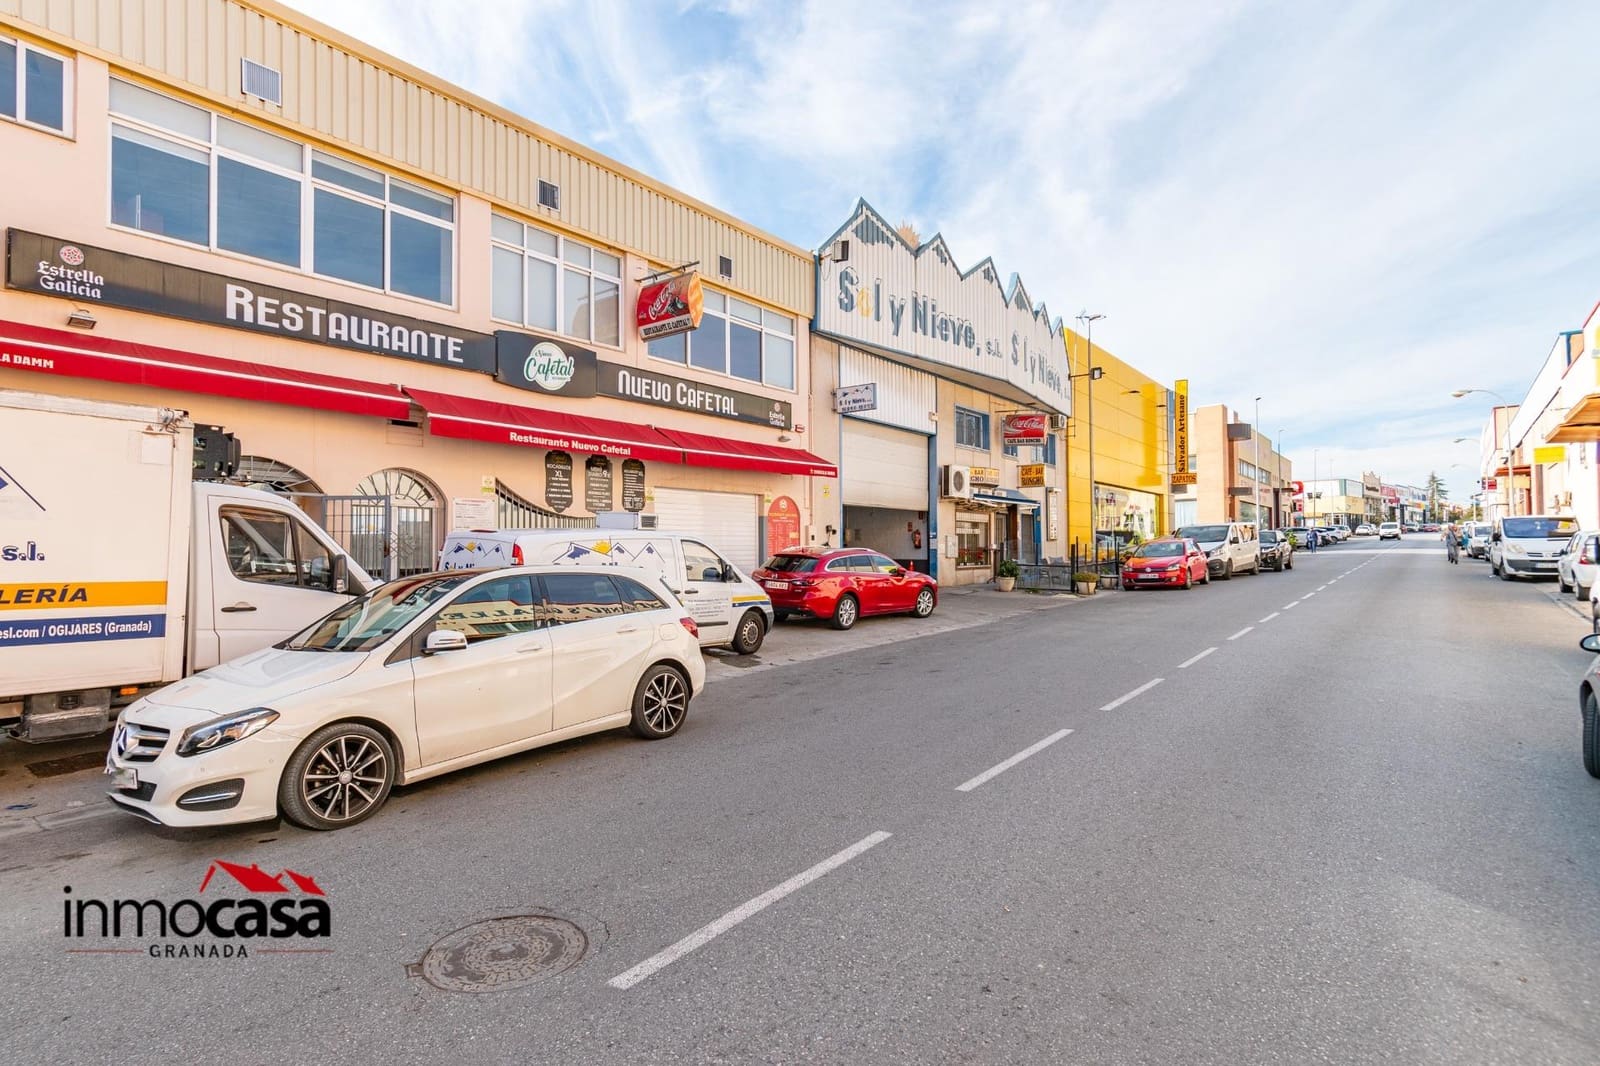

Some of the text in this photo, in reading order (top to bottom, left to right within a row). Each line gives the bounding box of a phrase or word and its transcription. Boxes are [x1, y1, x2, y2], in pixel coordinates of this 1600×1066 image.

[37, 261, 104, 286] Estrella
[40, 275, 102, 299] Galicia
[226, 283, 464, 363] RESTAURANTE
[13, 354, 54, 369] DAMM
[526, 356, 574, 381] Cafetal
[618, 370, 738, 416] NUEVO CAFETAL
[509, 431, 631, 456] Restaurante Nuevo Cafetal
[1178, 394, 1186, 473] Salvador Artesano
[1172, 475, 1197, 484] ZAPATOS
[1, 540, 45, 561] s.l.
[48, 622, 102, 637] OGIJARES
[105, 620, 152, 636] (Granada)
